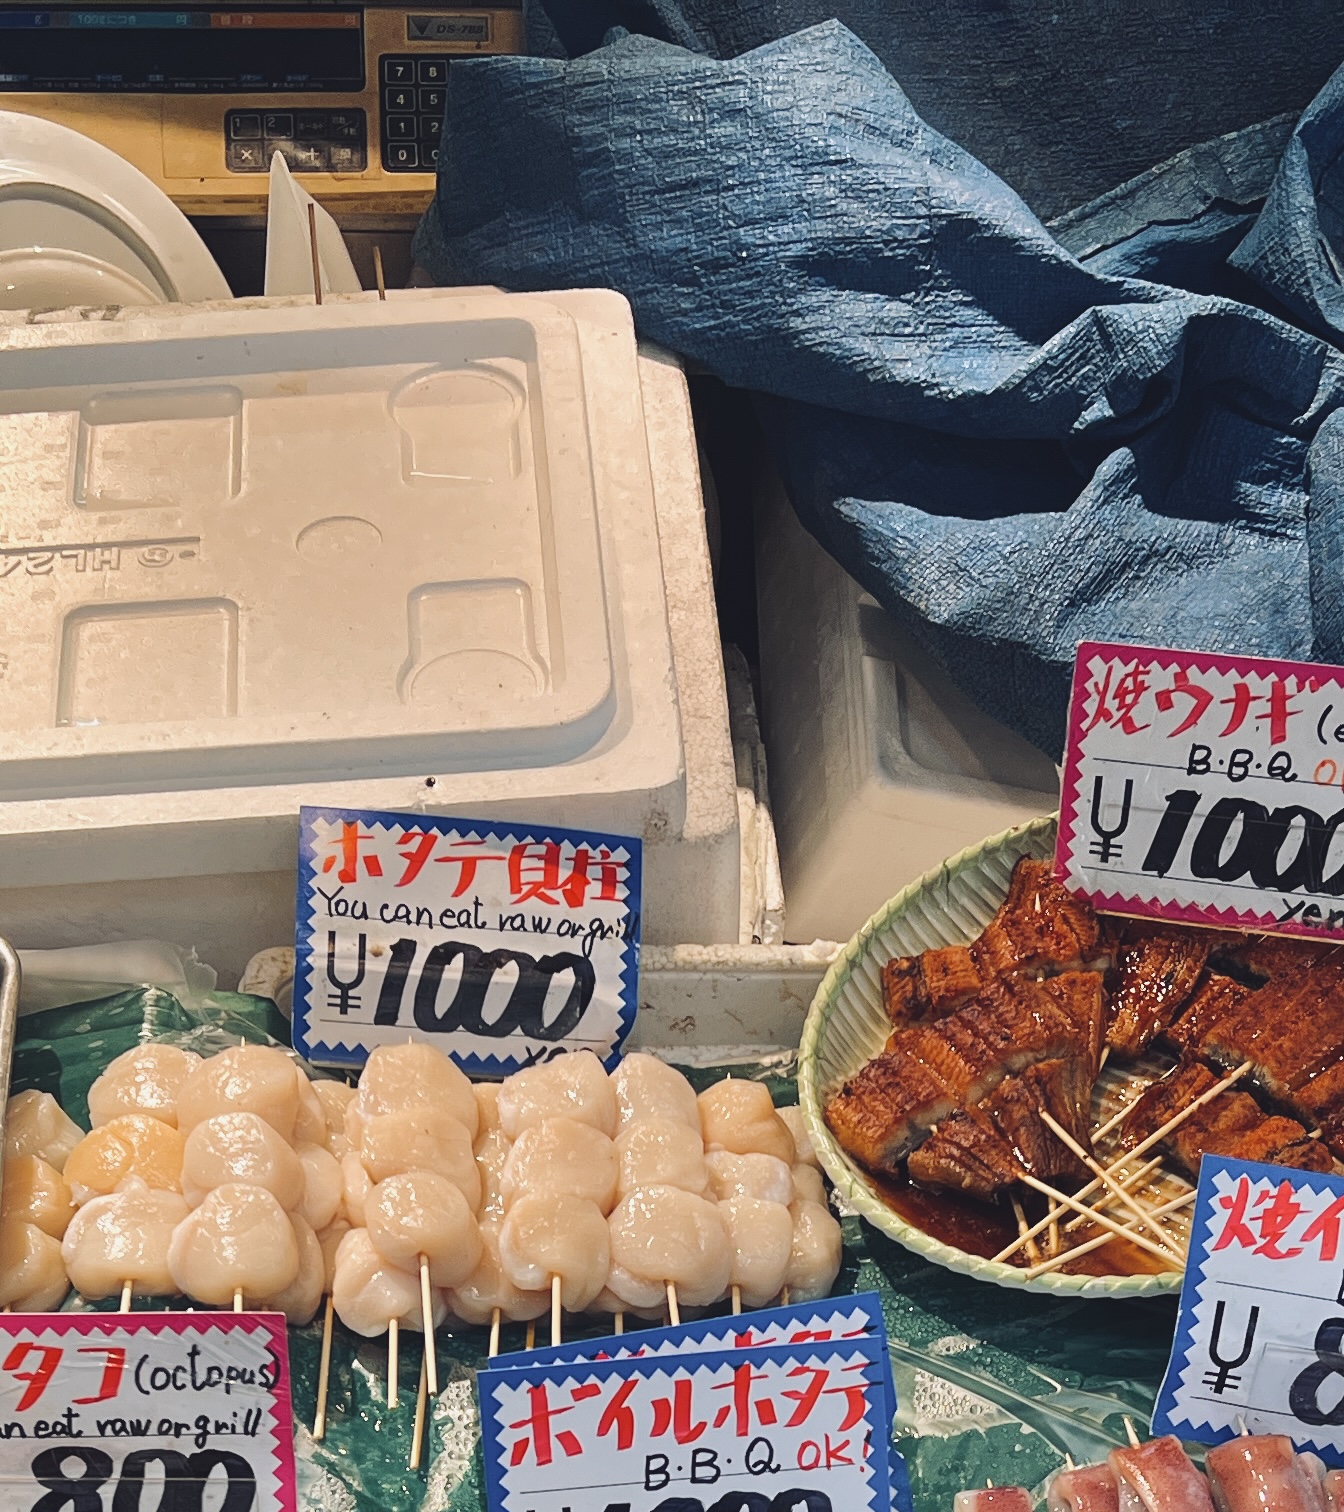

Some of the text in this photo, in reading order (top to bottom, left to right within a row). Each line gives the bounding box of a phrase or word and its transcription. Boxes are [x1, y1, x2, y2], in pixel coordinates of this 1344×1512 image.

[394, 66, 438, 78] 7 8
[396, 94, 439, 105] 4 5
[398, 122, 439, 133] 1 2
[1086, 663, 1322, 746] 焼ウナギ
[321, 820, 625, 910] ホタテ貝柱
[316, 885, 370, 922] You
[378, 900, 435, 930] can
[438, 895, 488, 931] eat
[498, 911, 553, 935] raw
[556, 917, 587, 939] or
[134, 1343, 282, 1396] (octopus)
[33, 1406, 83, 1440] eat
[96, 1416, 152, 1441] raw
[157, 1418, 191, 1439] or
[194, 1407, 263, 1450] grill
[509, 1361, 885, 1468] ボイルホタテ
[796, 1430, 875, 1473] OK!
